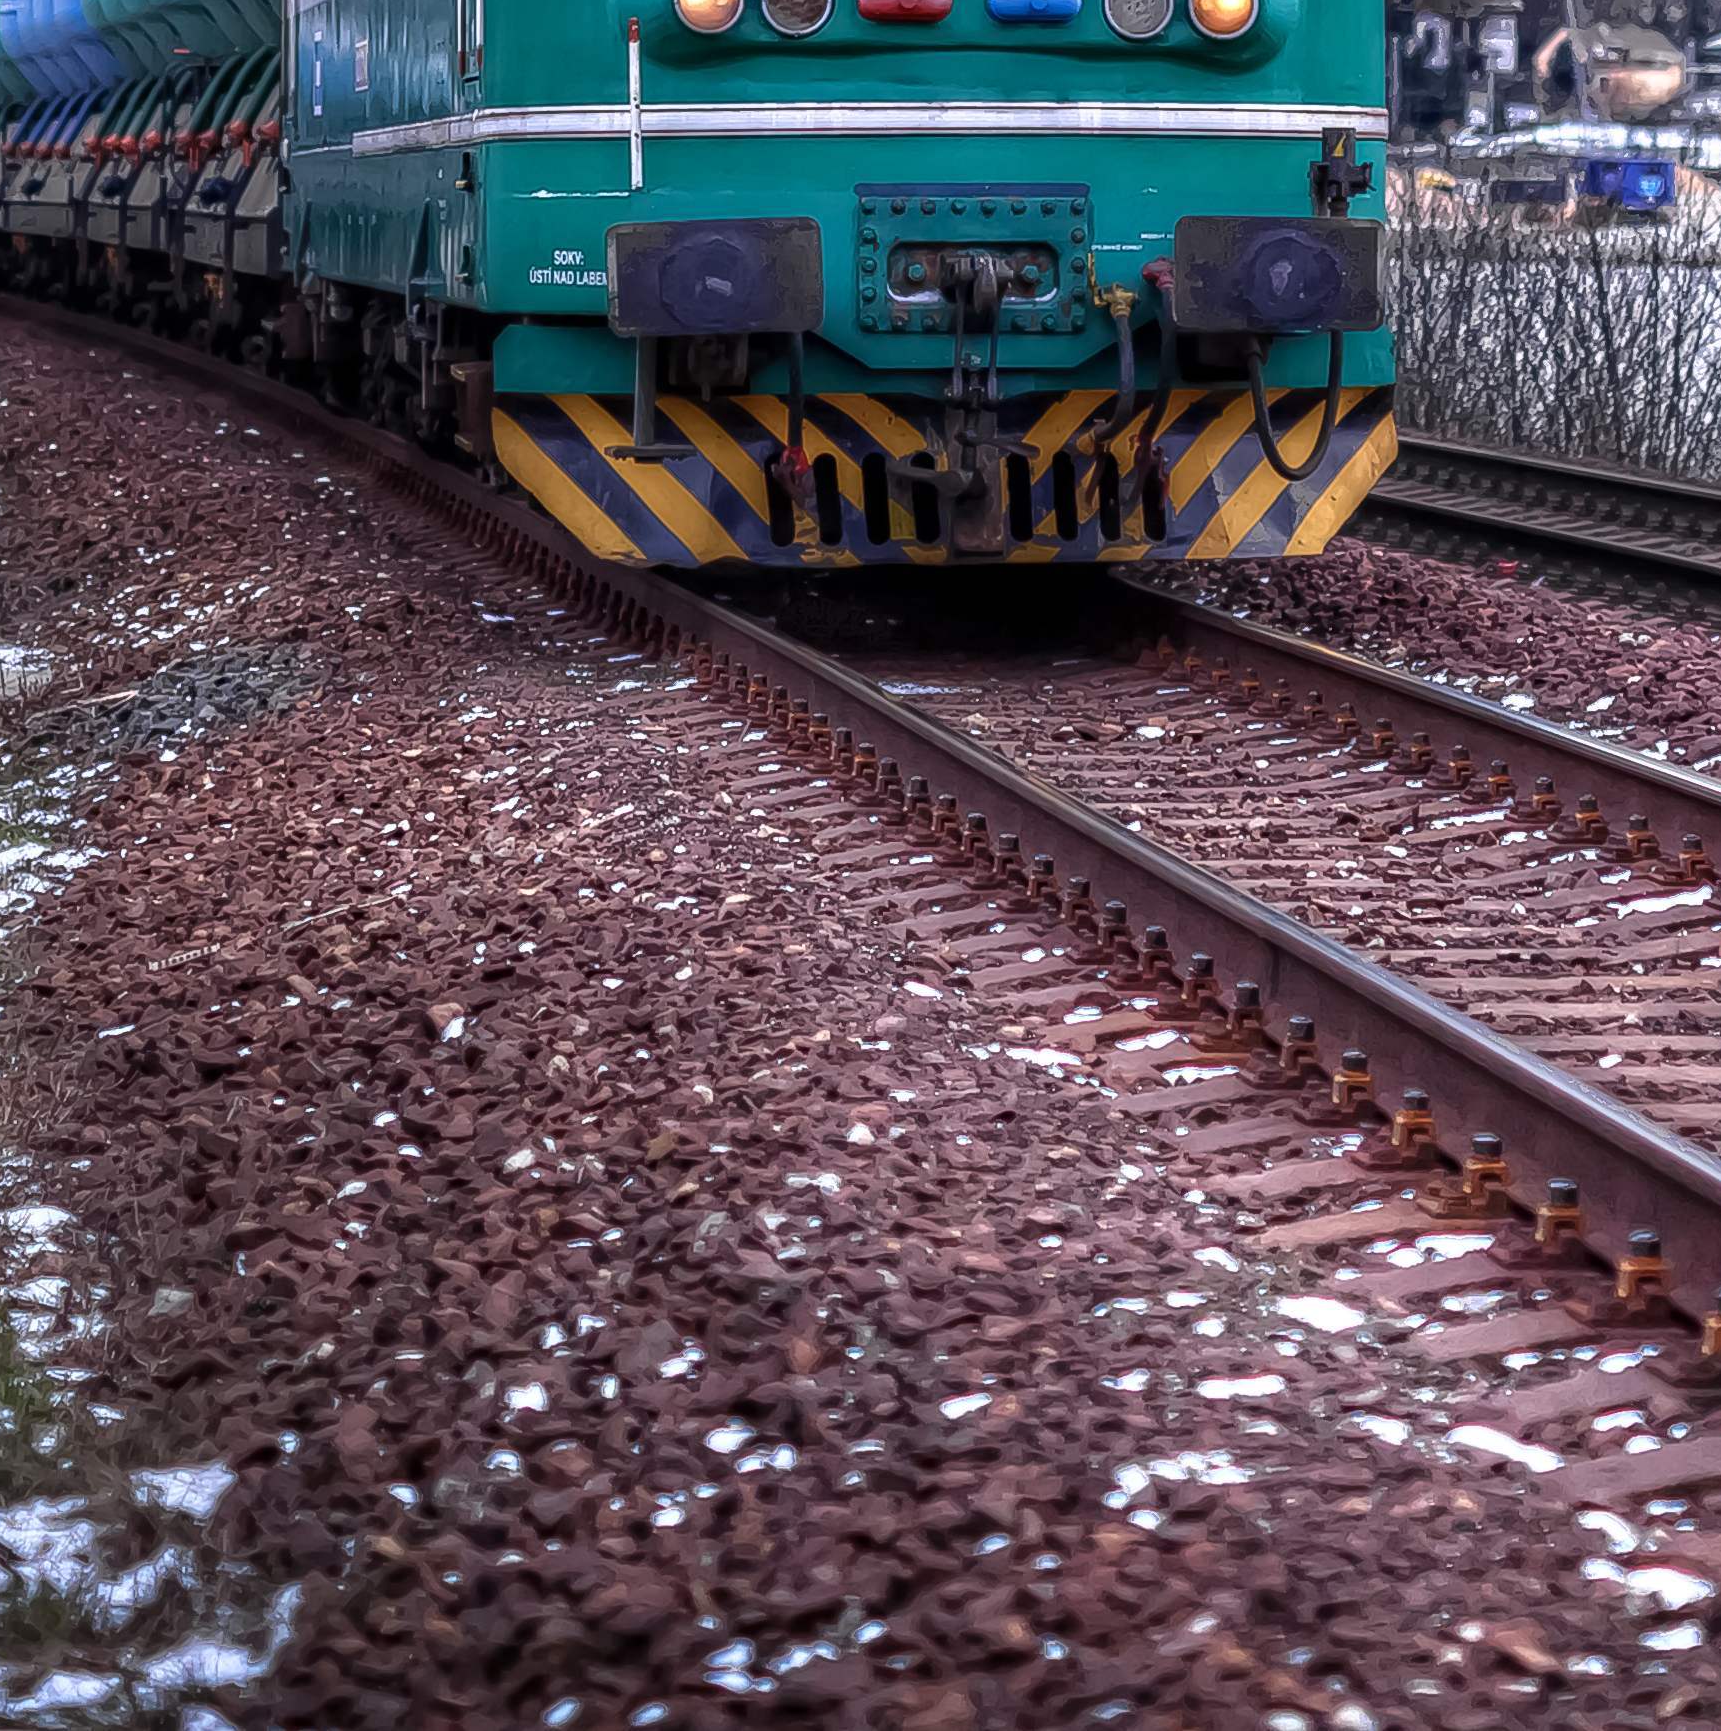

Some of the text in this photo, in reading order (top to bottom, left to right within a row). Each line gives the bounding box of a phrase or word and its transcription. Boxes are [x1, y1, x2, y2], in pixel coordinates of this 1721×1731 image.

[553, 250, 584, 265] SOKV:
[529, 266, 552, 284] ÚSTÍ
[553, 270, 575, 285] NAD
